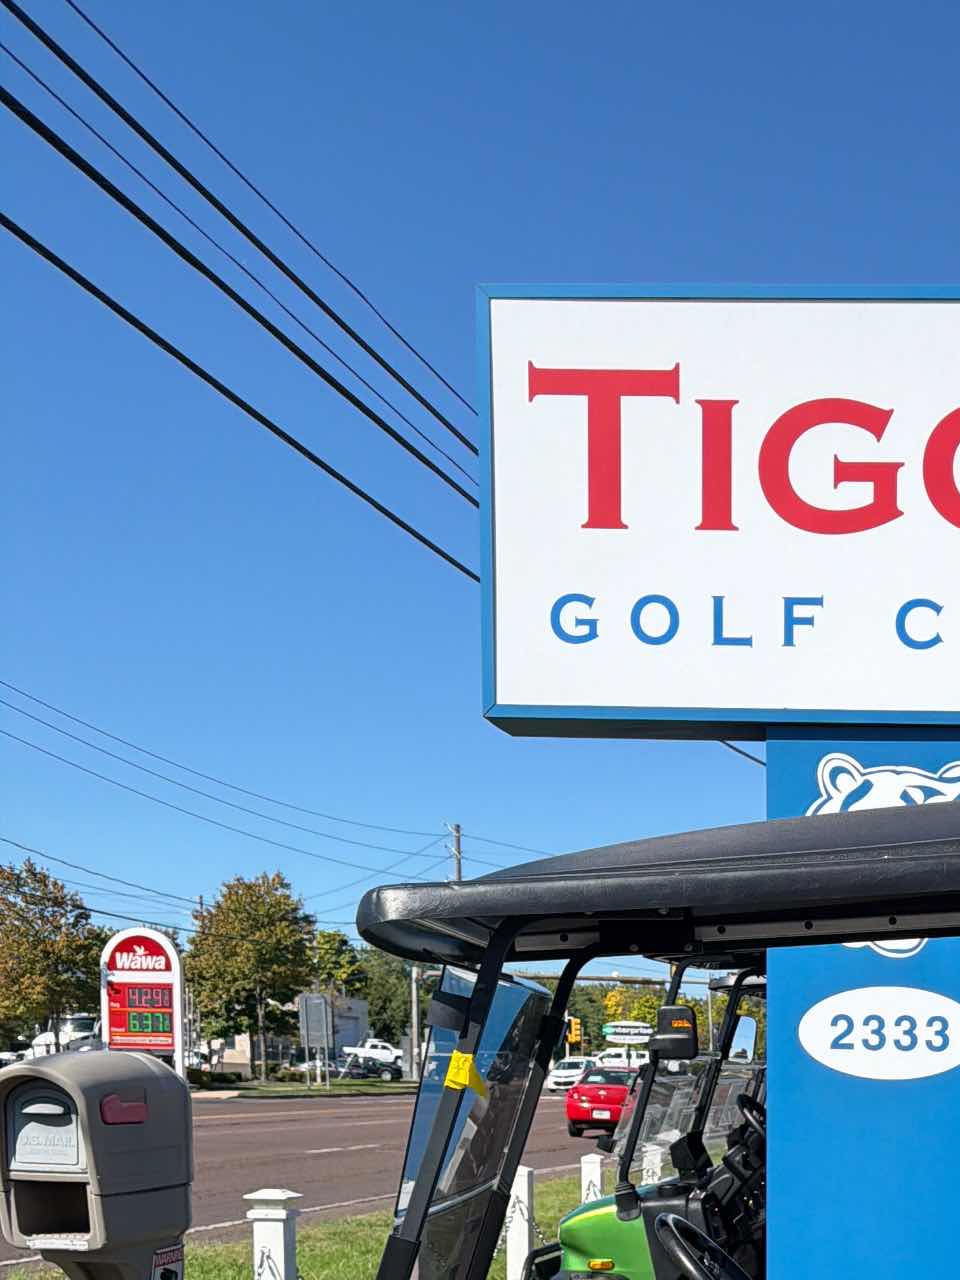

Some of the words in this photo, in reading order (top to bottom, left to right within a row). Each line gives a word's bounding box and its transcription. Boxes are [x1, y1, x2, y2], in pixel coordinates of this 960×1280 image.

[550, 593, 824, 648] GOLF
[115, 952, 166, 970] Wawa
[830, 1014, 950, 1052] 2333
